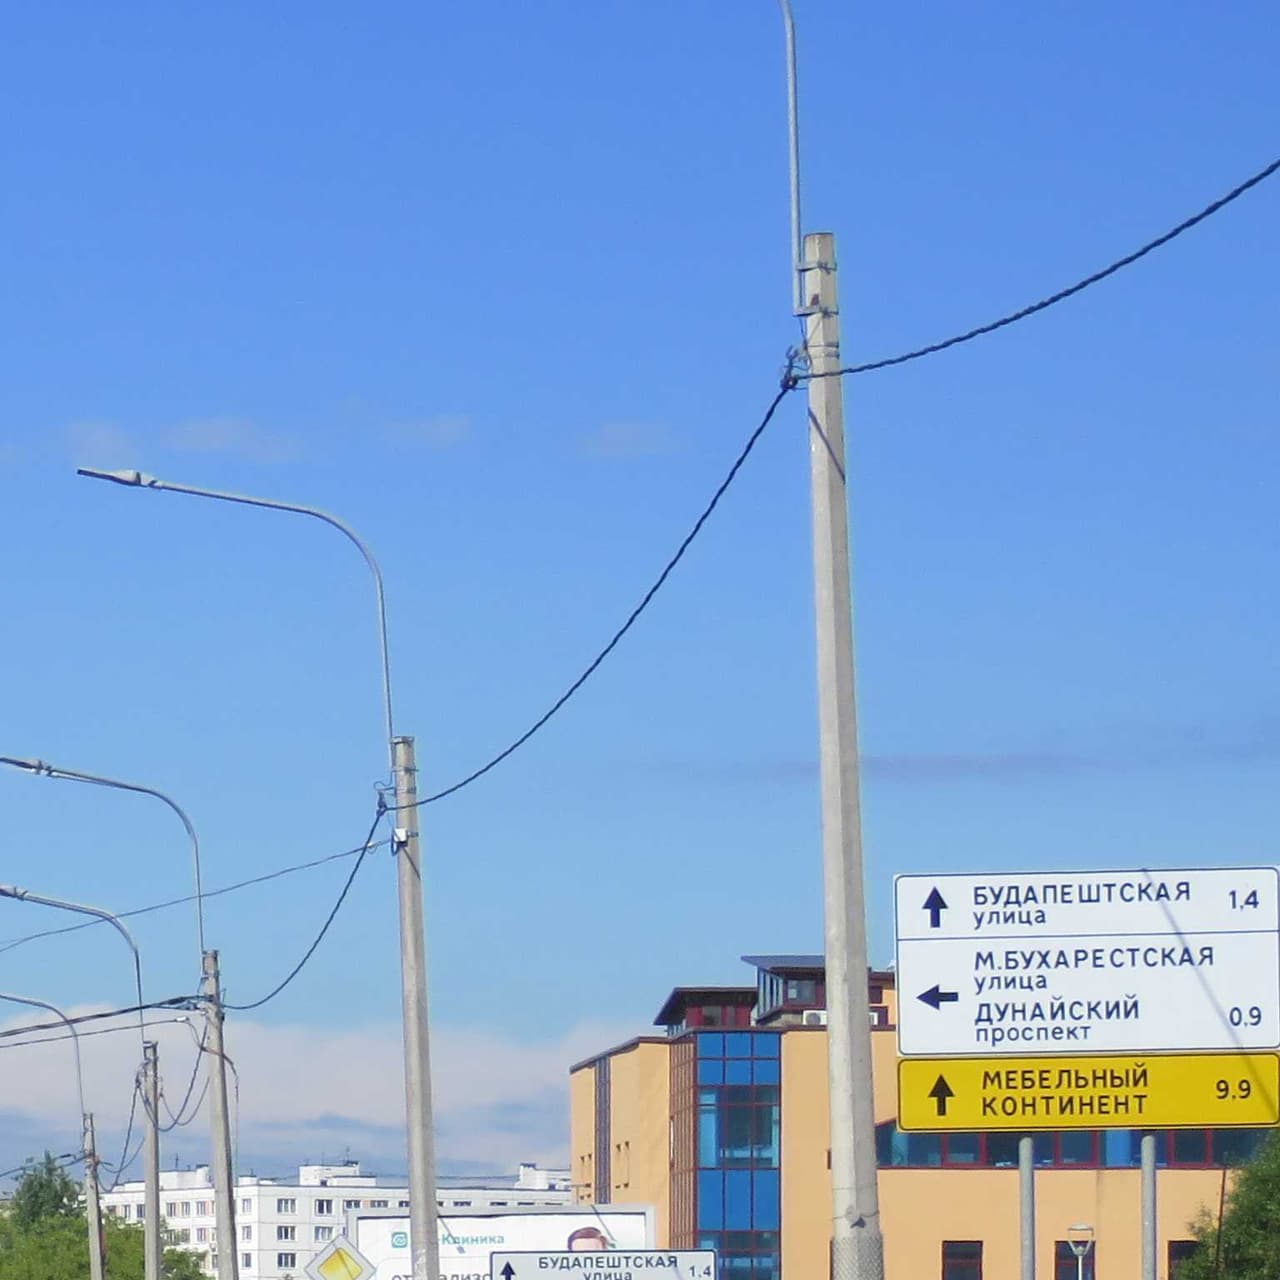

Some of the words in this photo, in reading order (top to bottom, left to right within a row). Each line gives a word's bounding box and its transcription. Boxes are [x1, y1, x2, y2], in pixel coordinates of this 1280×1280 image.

[973, 882, 1191, 908] БУДАПЕШТСКАЯ
[973, 908, 1047, 930] улица
[974, 946, 1215, 971] М.БУХАРЕСТСКАЯ
[974, 974, 1048, 995] улица
[974, 994, 1140, 1025] ДУНАЙСКИЙ
[975, 1025, 1092, 1047] проспект
[982, 1062, 1149, 1091] МЕБЕЛЬНЫЙ
[982, 1094, 1148, 1116] КОНТИНЕНТ
[539, 1255, 678, 1271] БУДАПЕШТСКАЯ
